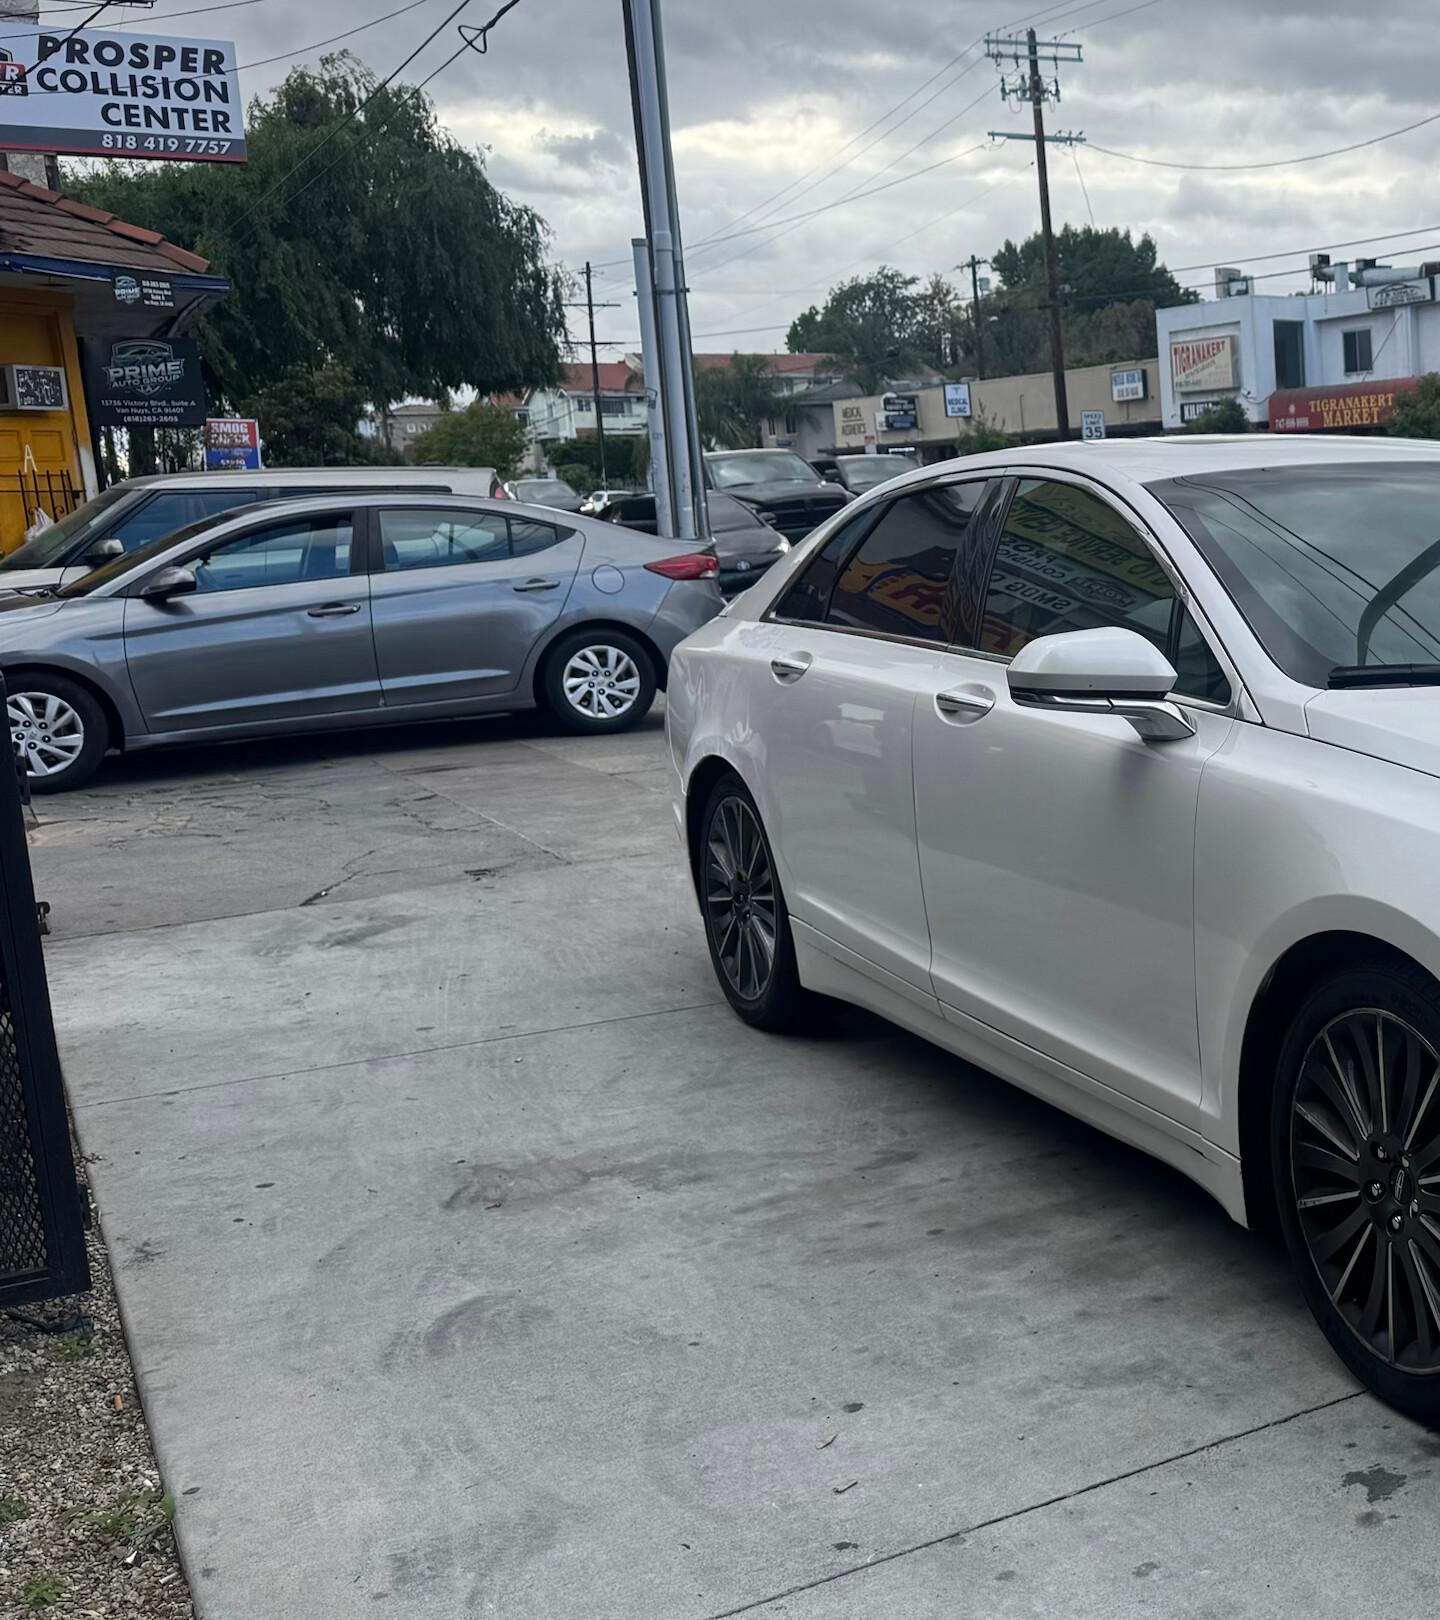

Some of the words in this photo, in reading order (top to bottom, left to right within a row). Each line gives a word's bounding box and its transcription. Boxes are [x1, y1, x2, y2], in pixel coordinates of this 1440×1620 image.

[38, 35, 226, 76] PROSPER
[36, 68, 230, 104] COLLISION
[101, 102, 232, 133] CENTER
[101, 133, 137, 149] 818
[144, 137, 178, 152] 419
[185, 139, 232, 155] 7757
[1173, 341, 1225, 377] TIGRANAKERT
[108, 361, 181, 381] PRIME
[112, 379, 140, 388] AUTO
[142, 374, 180, 384] GROUP
[1309, 393, 1394, 412] TIGRANAKERT
[211, 422, 248, 432] SMOG
[1323, 407, 1380, 428] MARKET
[1085, 427, 1103, 438] 35
[24, 444, 38, 472] A
